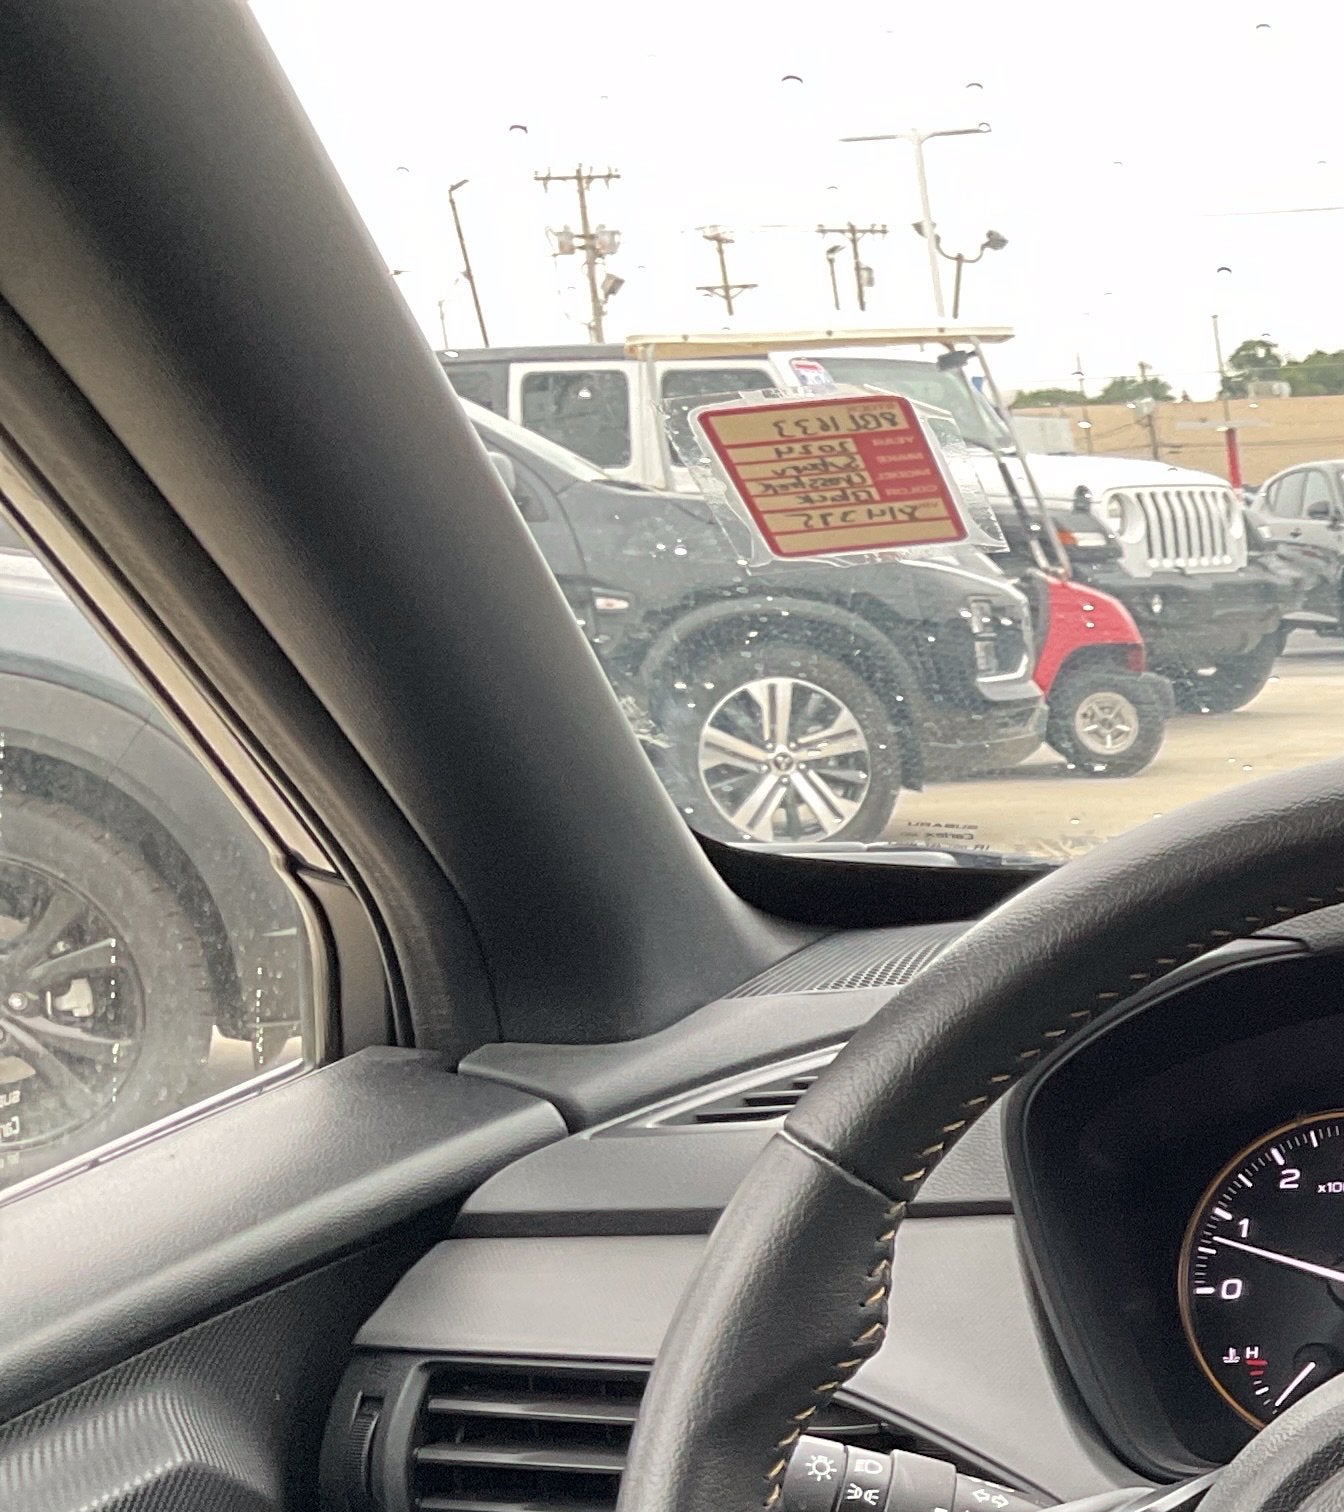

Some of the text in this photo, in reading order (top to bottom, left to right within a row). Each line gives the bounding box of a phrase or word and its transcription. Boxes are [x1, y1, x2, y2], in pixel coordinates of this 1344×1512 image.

[1278, 1169, 1301, 1190] 2
[1237, 1218, 1250, 1238] 1
[1220, 1277, 1244, 1300] 0
[1246, 1346, 1260, 1360] H
